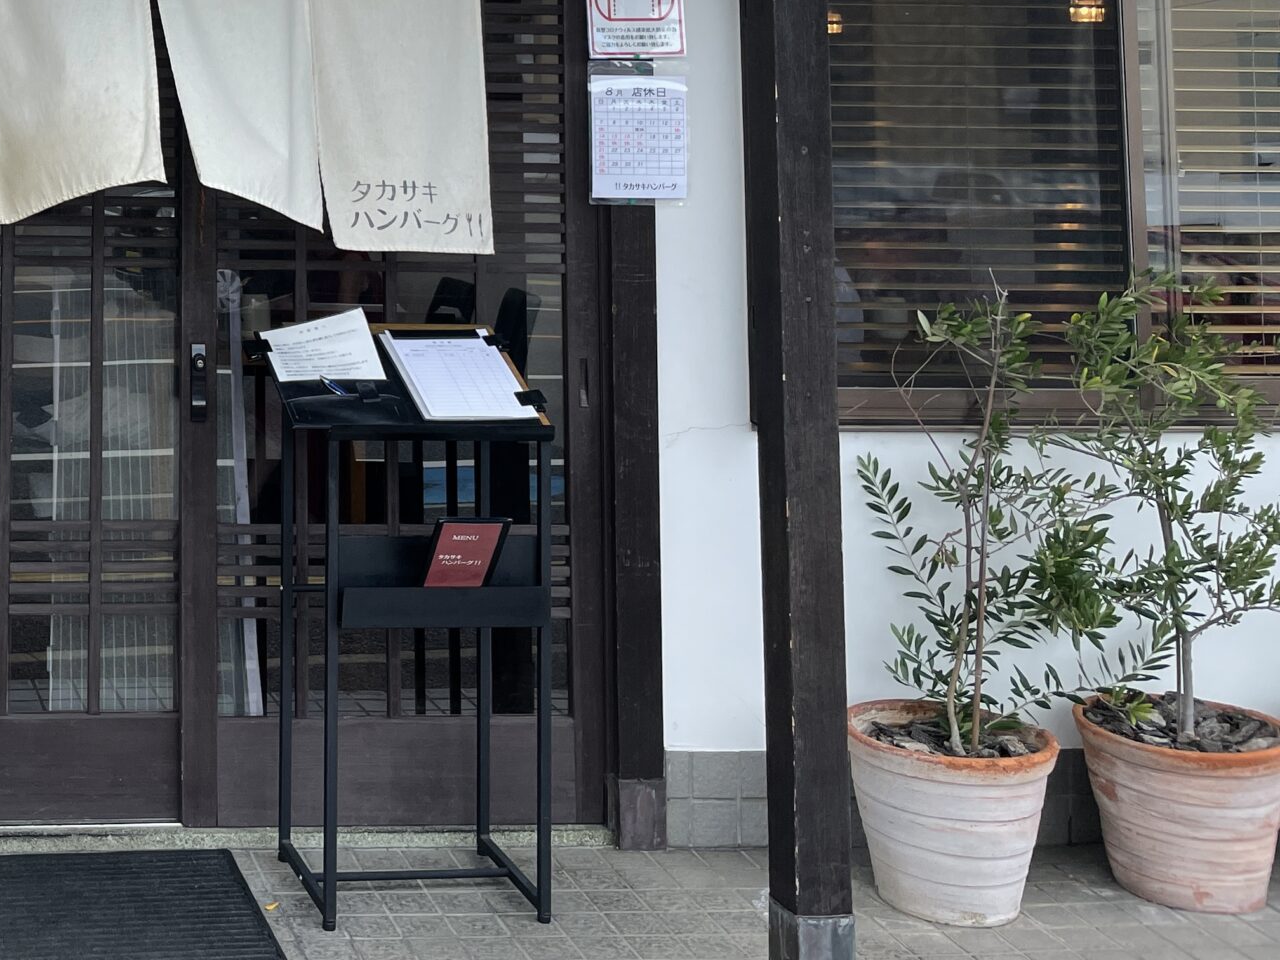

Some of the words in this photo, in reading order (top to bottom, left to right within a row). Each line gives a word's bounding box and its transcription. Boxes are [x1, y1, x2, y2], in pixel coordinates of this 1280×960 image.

[631, 87, 666, 97] 店休日
[351, 179, 438, 204] タカサキ
[622, 182, 678, 191] タカサキハンバーグ
[350, 208, 461, 235] ハンバーグ
